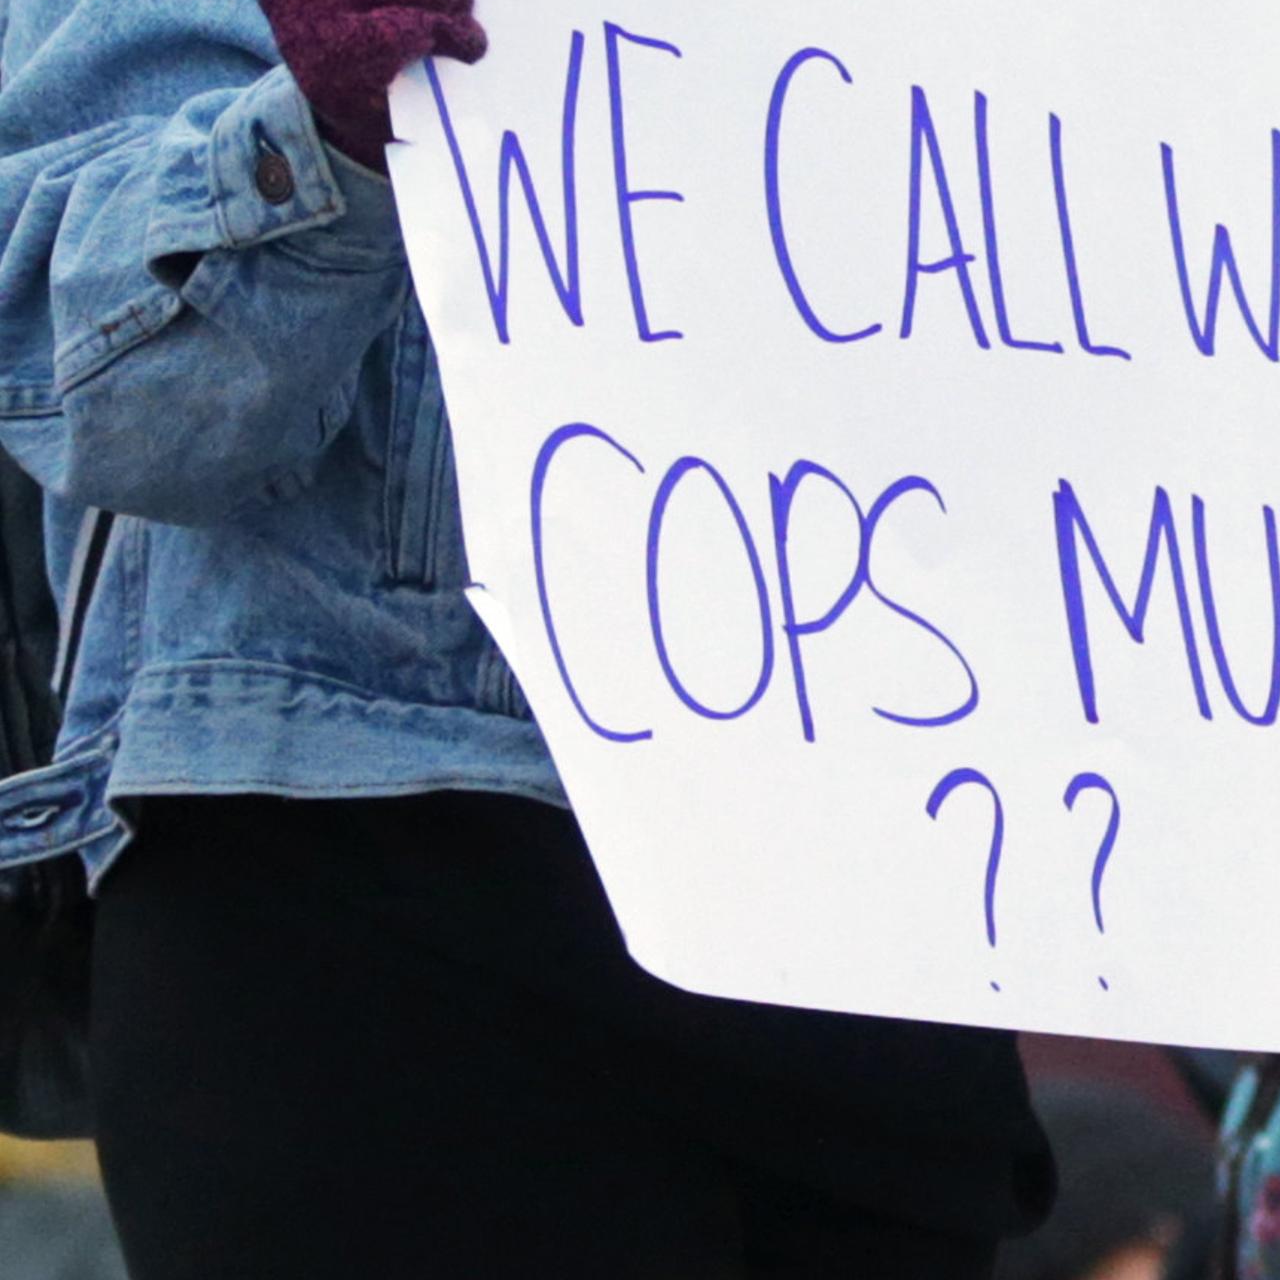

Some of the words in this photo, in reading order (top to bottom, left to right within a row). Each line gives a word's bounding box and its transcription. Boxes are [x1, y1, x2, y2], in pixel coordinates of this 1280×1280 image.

[422, 21, 684, 344] WE
[764, 47, 1131, 360] CALL
[531, 422, 979, 743] COPS
